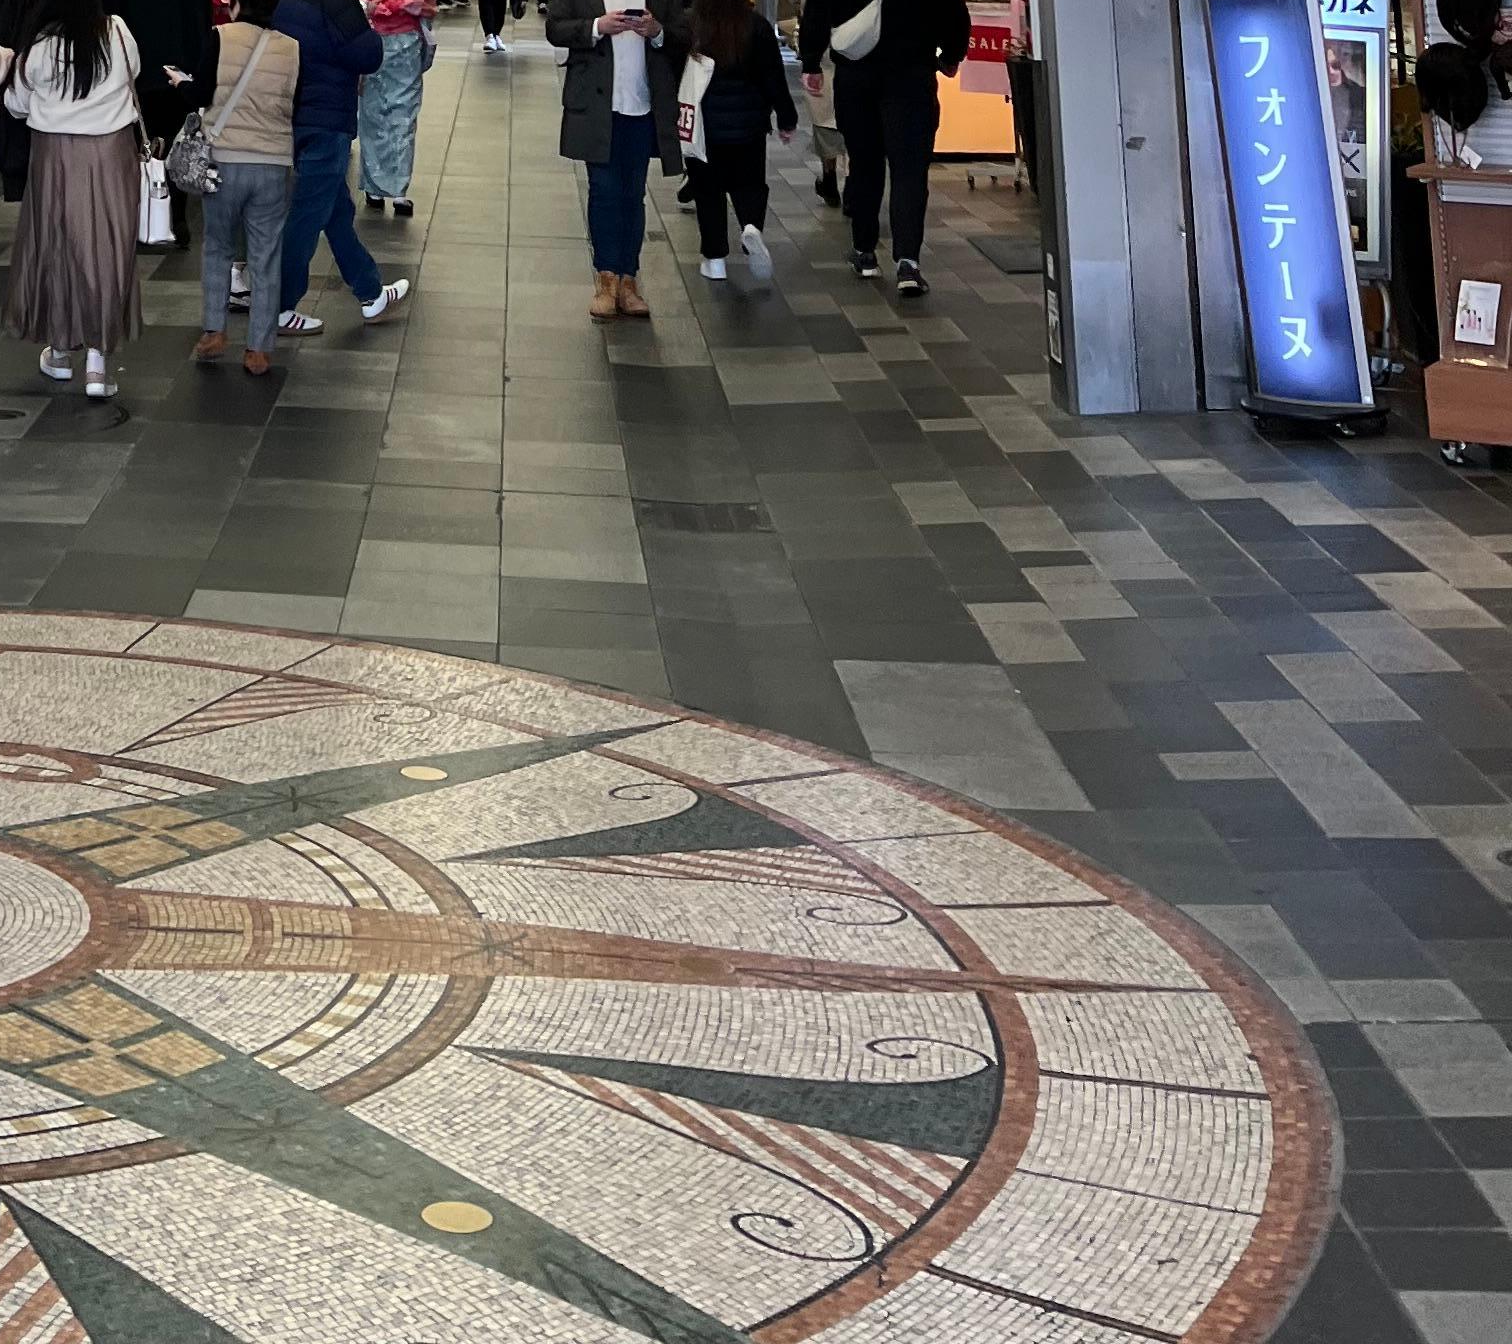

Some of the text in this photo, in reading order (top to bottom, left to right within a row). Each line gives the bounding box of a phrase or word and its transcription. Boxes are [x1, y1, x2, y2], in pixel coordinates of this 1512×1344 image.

[1238, 34, 1313, 360] フォンテーヌ
